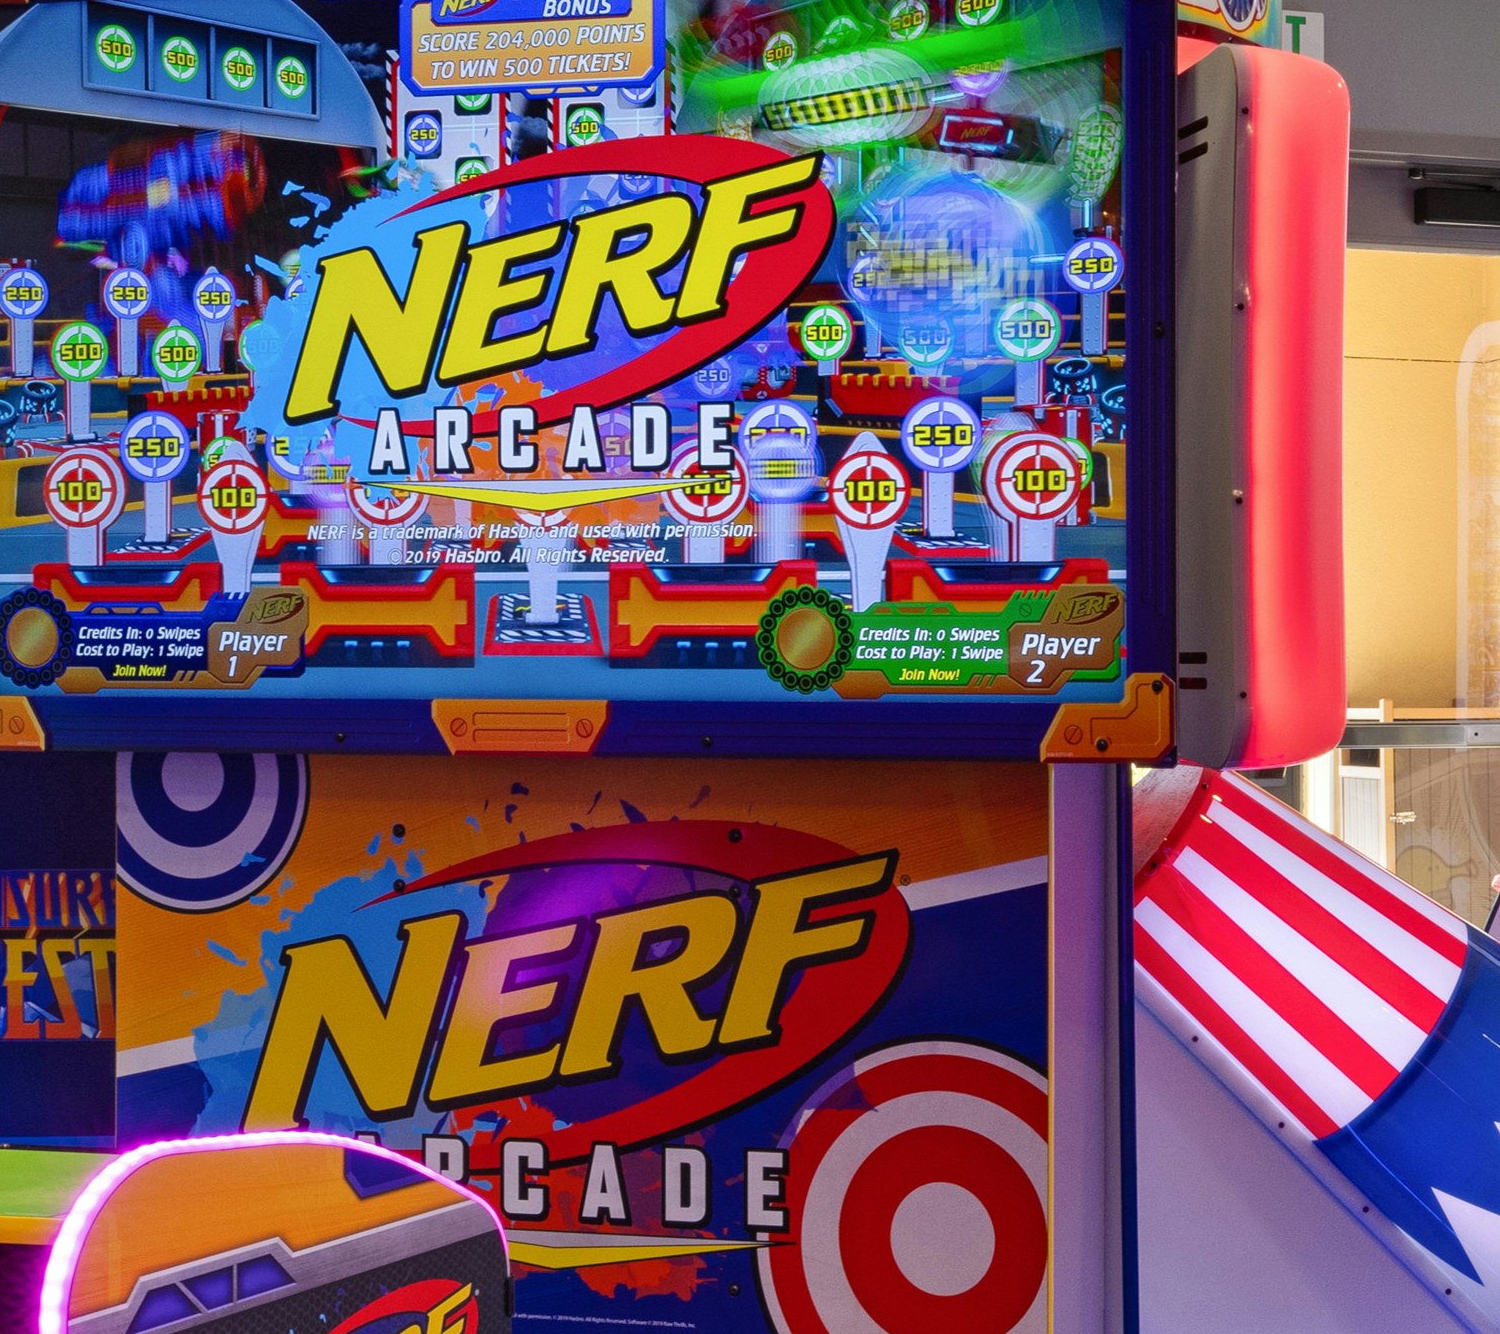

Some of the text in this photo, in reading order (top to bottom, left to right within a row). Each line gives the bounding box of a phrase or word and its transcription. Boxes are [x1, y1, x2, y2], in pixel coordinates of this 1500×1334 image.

[418, 23, 646, 53] SCORE 204,000 POINTS
[431, 52, 632, 80] TO WIN 500 TICKETS!
[285, 151, 826, 420] NERF
[128, 436, 180, 457] 250
[367, 402, 737, 476] ARCADE
[912, 424, 973, 448] 250
[57, 480, 102, 502] 100
[845, 479, 896, 503] 100
[1015, 468, 1067, 493] 100
[307, 523, 759, 542] NERF trademark of Hasbro and used with permission.
[444, 547, 670, 566] Hasbro. All Rights Reserved.
[248, 595, 304, 623] NERF
[1051, 592, 1120, 624] NERF
[78, 626, 201, 642] Credits In: Swipes
[219, 631, 288, 655] Player
[859, 627, 1000, 644] Credits In: Swipes
[76, 643, 204, 659] Cost to Play: Swipe
[856, 645, 1003, 662] Cost to Play: Swipe
[1021, 633, 1101, 660] Player
[113, 665, 167, 677] Join Now!
[228, 655, 238, 677] 1
[899, 669, 960, 681] Join Now!
[1026, 659, 1047, 683] 2
[241, 847, 901, 1134] NERF
[355, 1131, 791, 1231] RCADE
